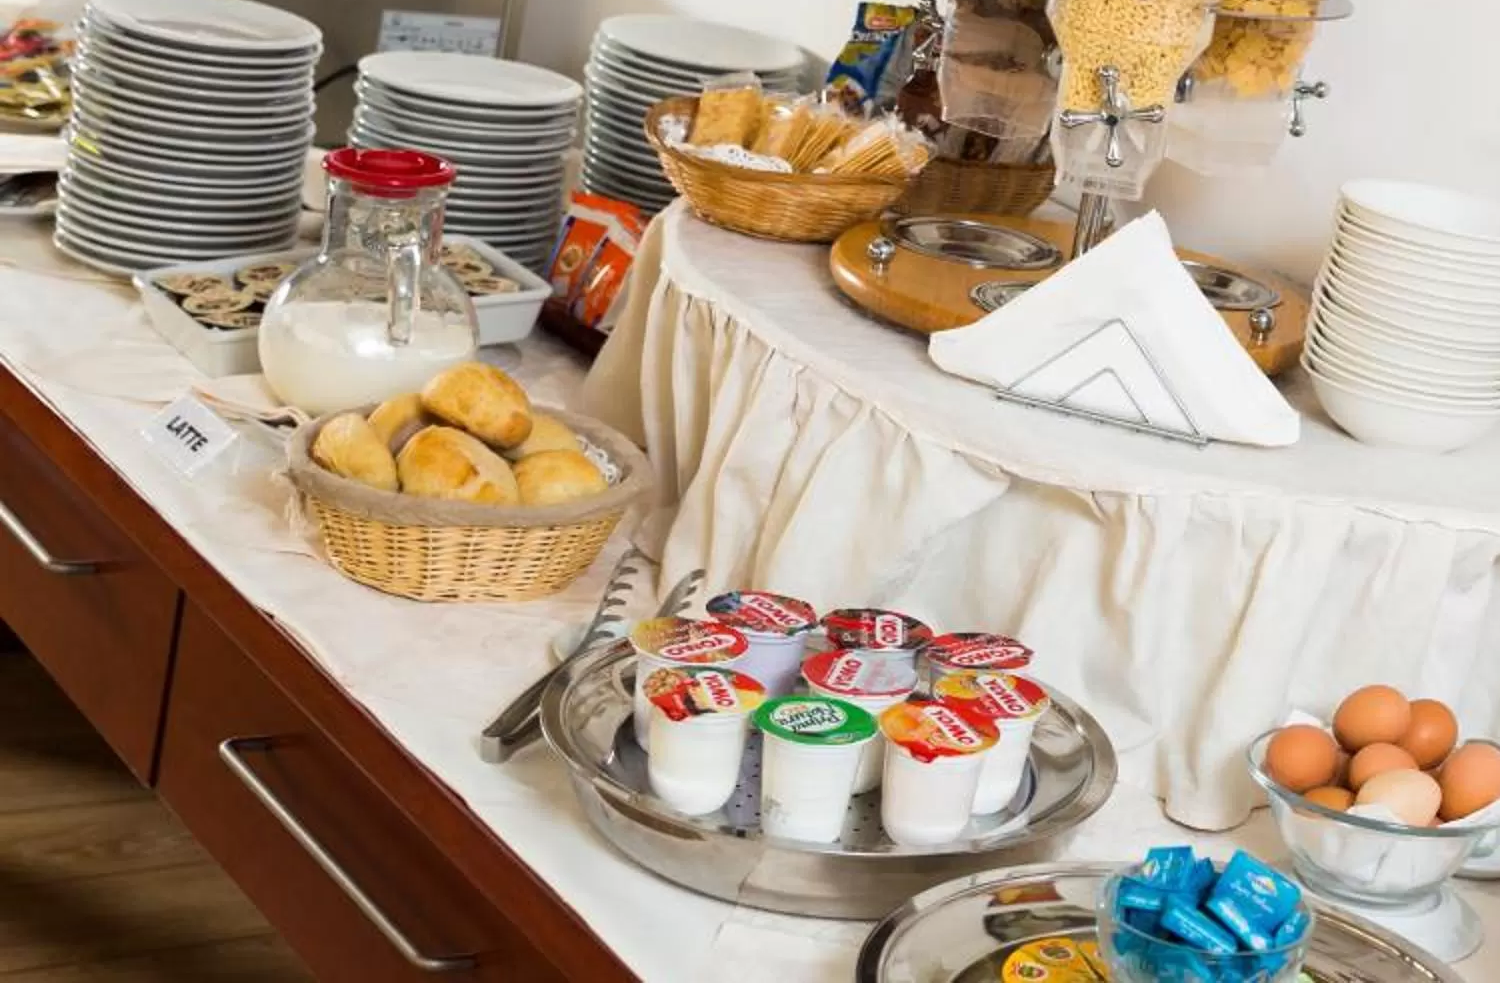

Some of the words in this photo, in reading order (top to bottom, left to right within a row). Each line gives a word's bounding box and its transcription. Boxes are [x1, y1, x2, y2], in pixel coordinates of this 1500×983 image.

[166, 415, 208, 452] LATTE
[749, 597, 800, 627] YOMO
[703, 673, 735, 708] YOMO
[984, 678, 1025, 713] YOMO
[929, 708, 976, 745] YOMO
